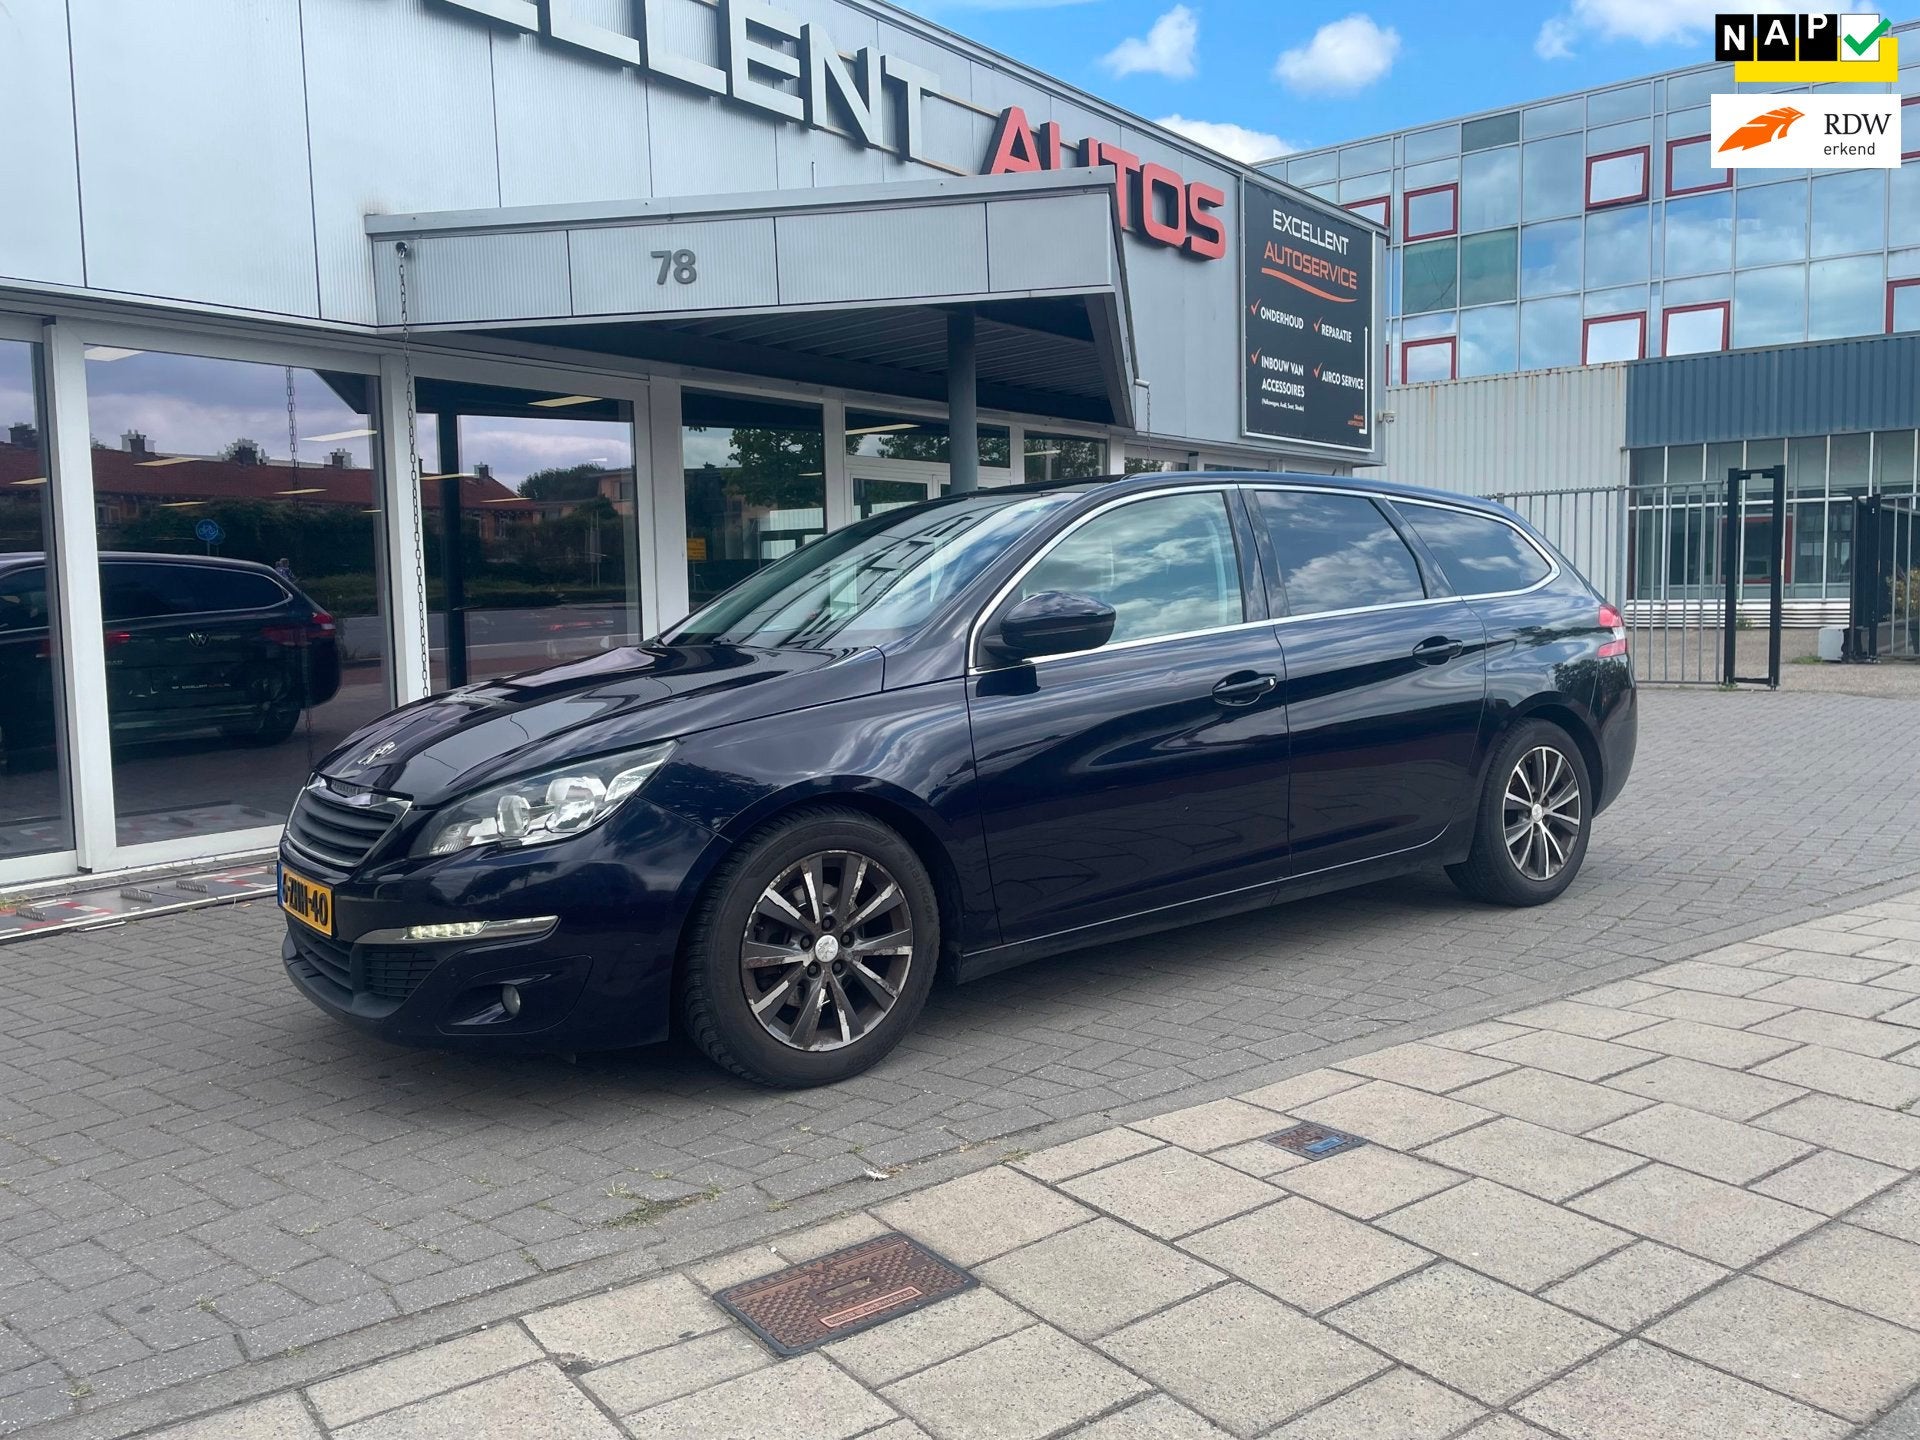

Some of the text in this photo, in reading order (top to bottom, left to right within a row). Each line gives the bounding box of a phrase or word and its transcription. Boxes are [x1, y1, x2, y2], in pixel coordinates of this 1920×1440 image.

[1272, 209, 1349, 255] EXCELLENT
[651, 248, 698, 285] 78
[1264, 240, 1358, 290] AUTOSERVICE
[1260, 306, 1304, 330] ONDERHOUD
[1321, 323, 1352, 343] REPARATIE
[1261, 355, 1304, 376] INBOUW VAN
[1261, 378, 1305, 398] ACCESSOIRES
[1322, 370, 1364, 390] AIRCO SERVICE
